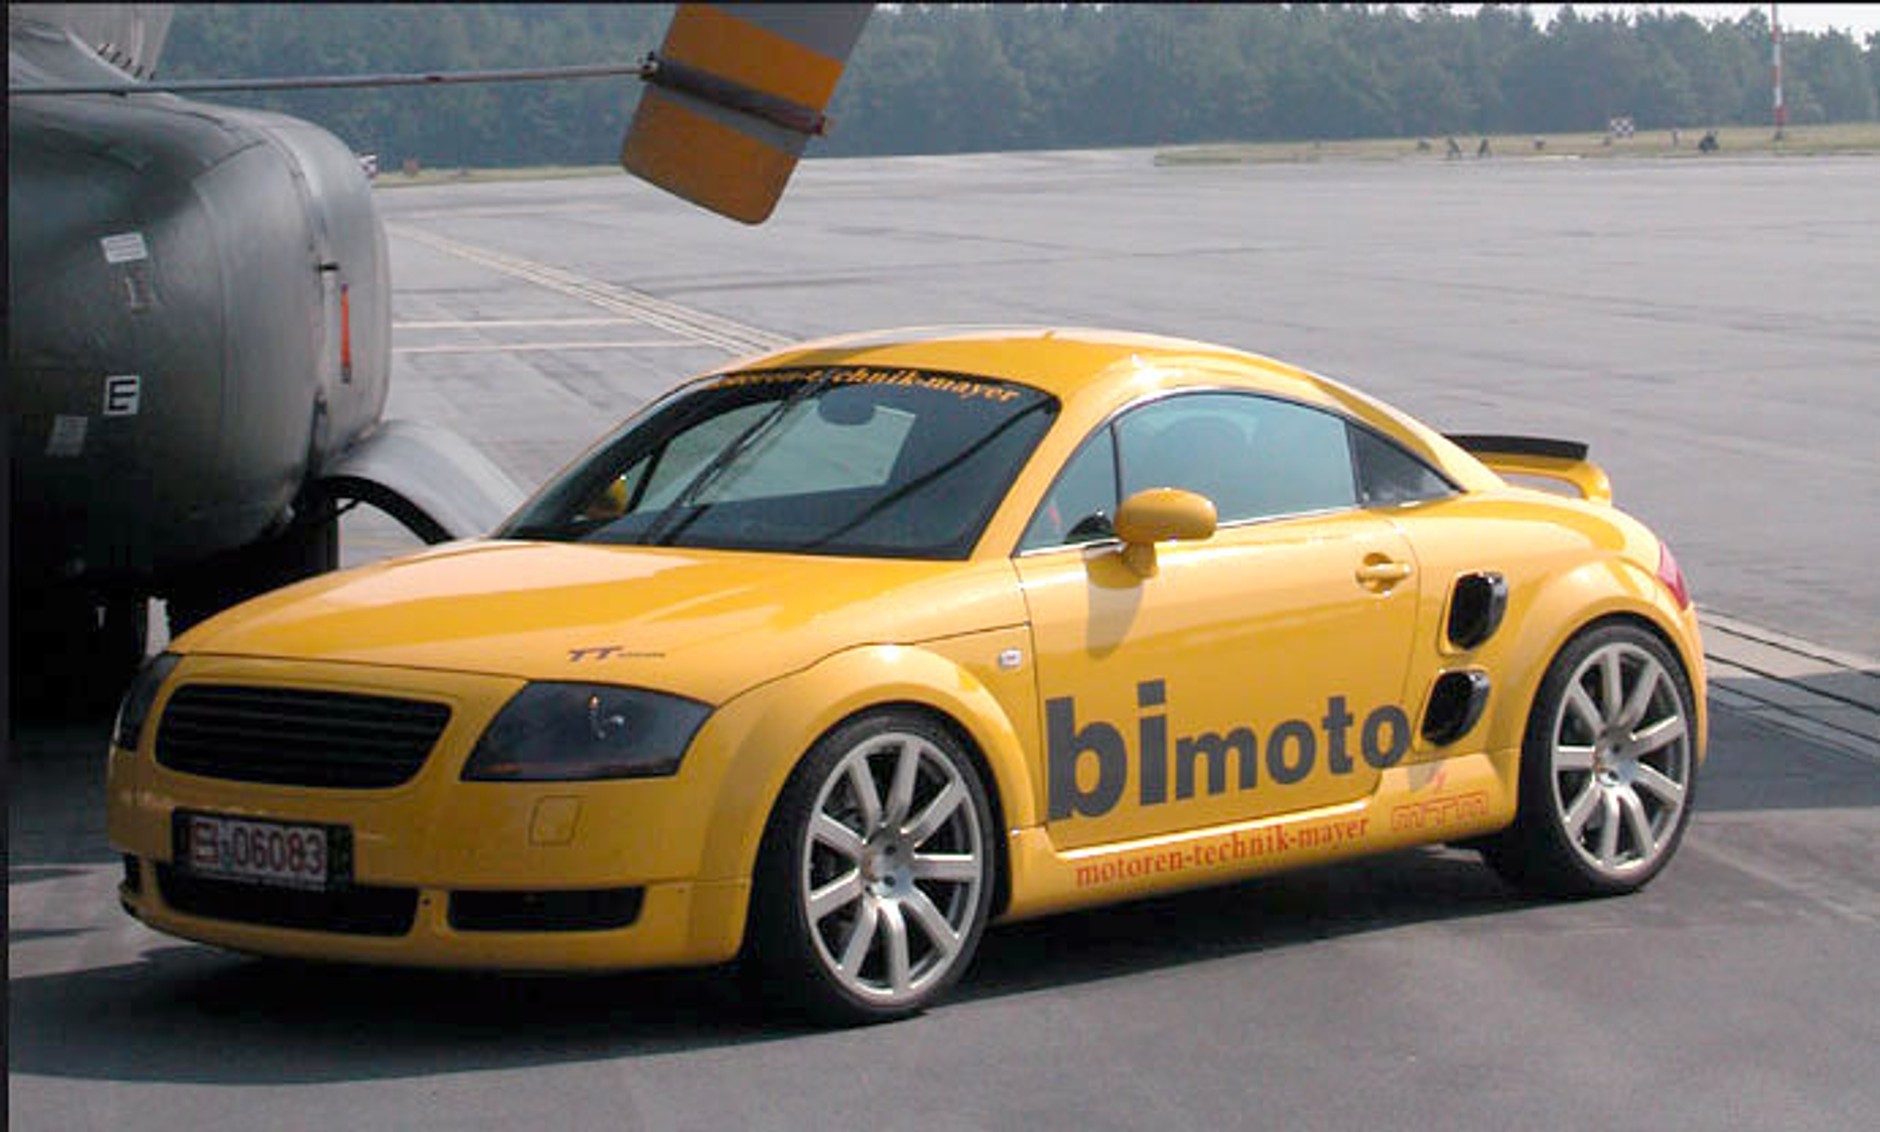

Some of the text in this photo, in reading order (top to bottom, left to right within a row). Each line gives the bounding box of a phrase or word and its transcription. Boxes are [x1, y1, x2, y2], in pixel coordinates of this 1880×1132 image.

[108, 379, 137, 410] E
[1045, 678, 1411, 822] bimoto
[1075, 817, 1369, 886] motoren-technik-mayer
